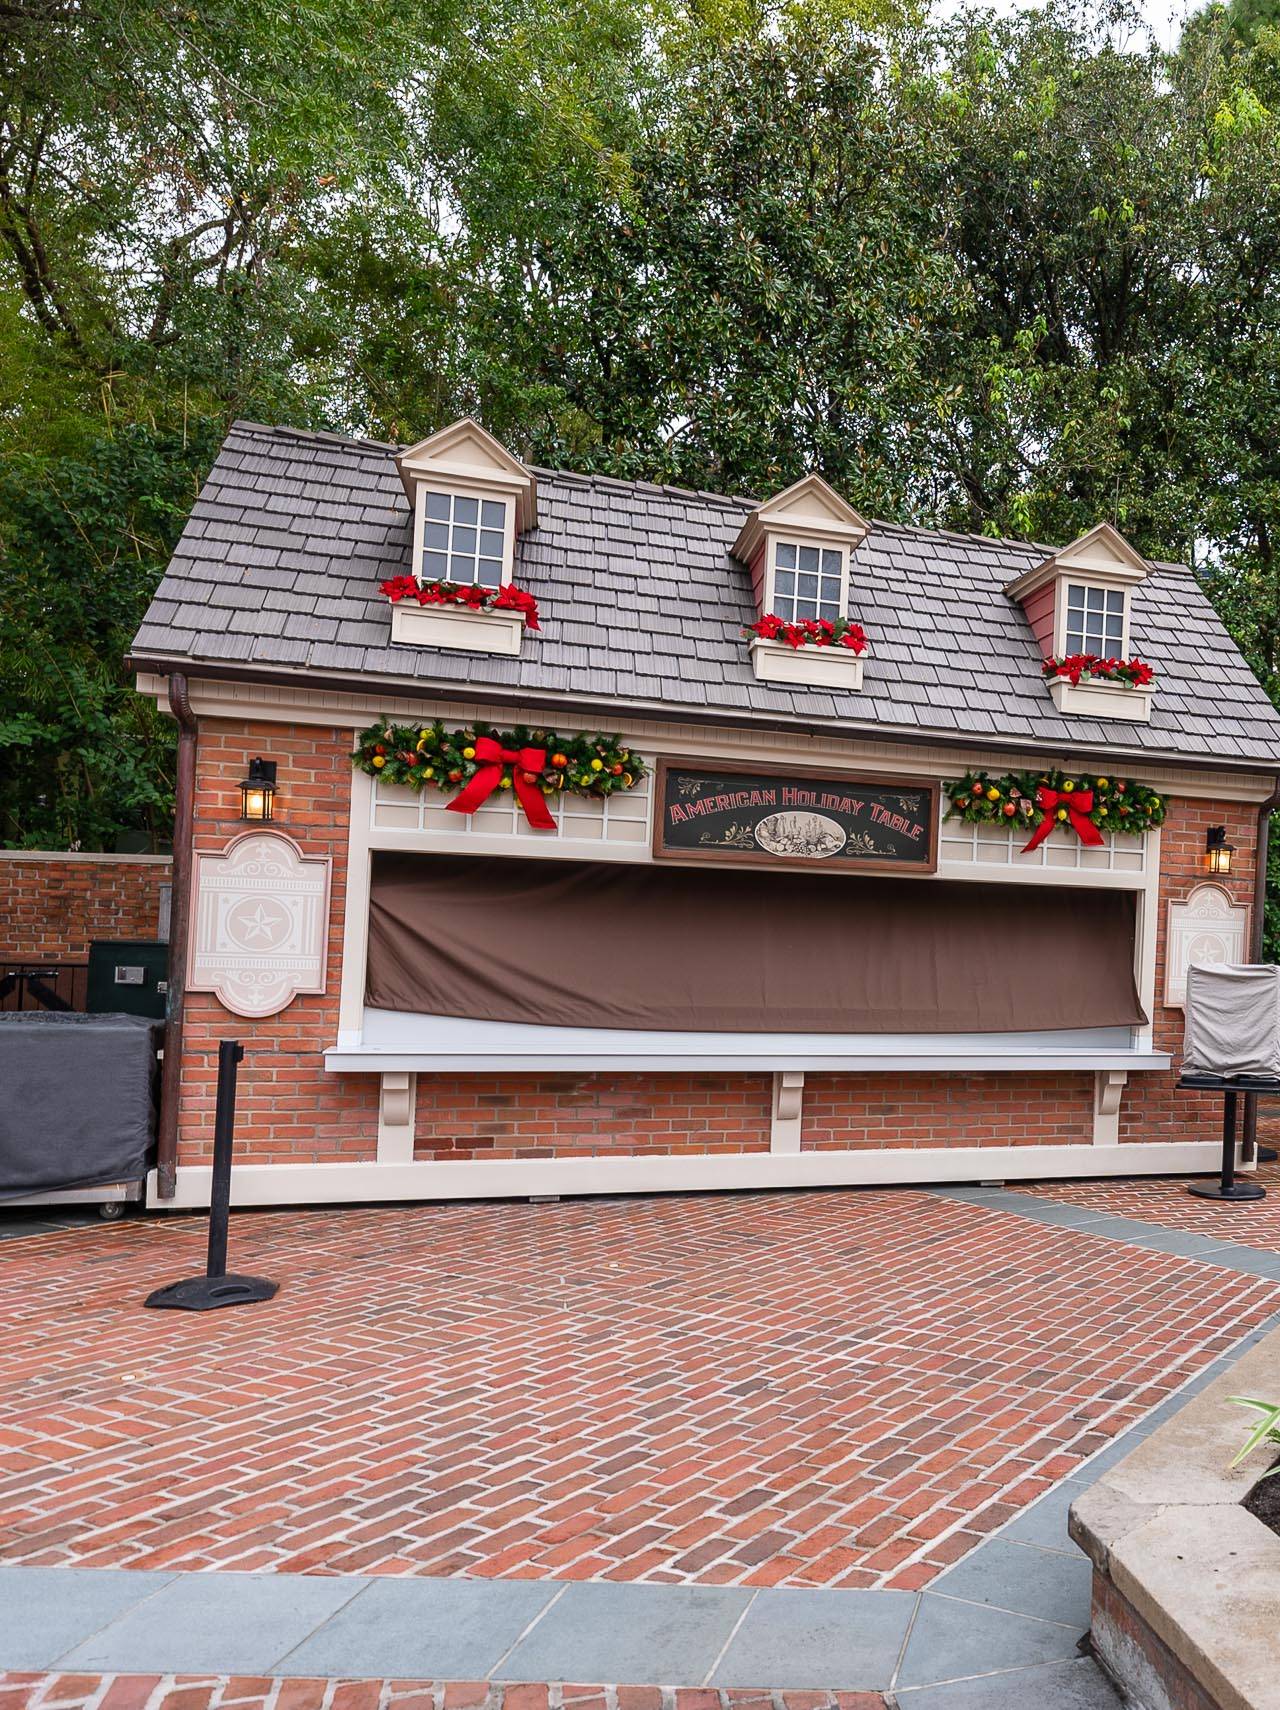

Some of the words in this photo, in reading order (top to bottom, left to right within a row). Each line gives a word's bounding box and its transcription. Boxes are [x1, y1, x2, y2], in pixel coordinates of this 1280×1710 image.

[669, 790, 777, 825] AMERICAN
[781, 787, 864, 816] HOLIDAY
[870, 802, 925, 841] TABLE
